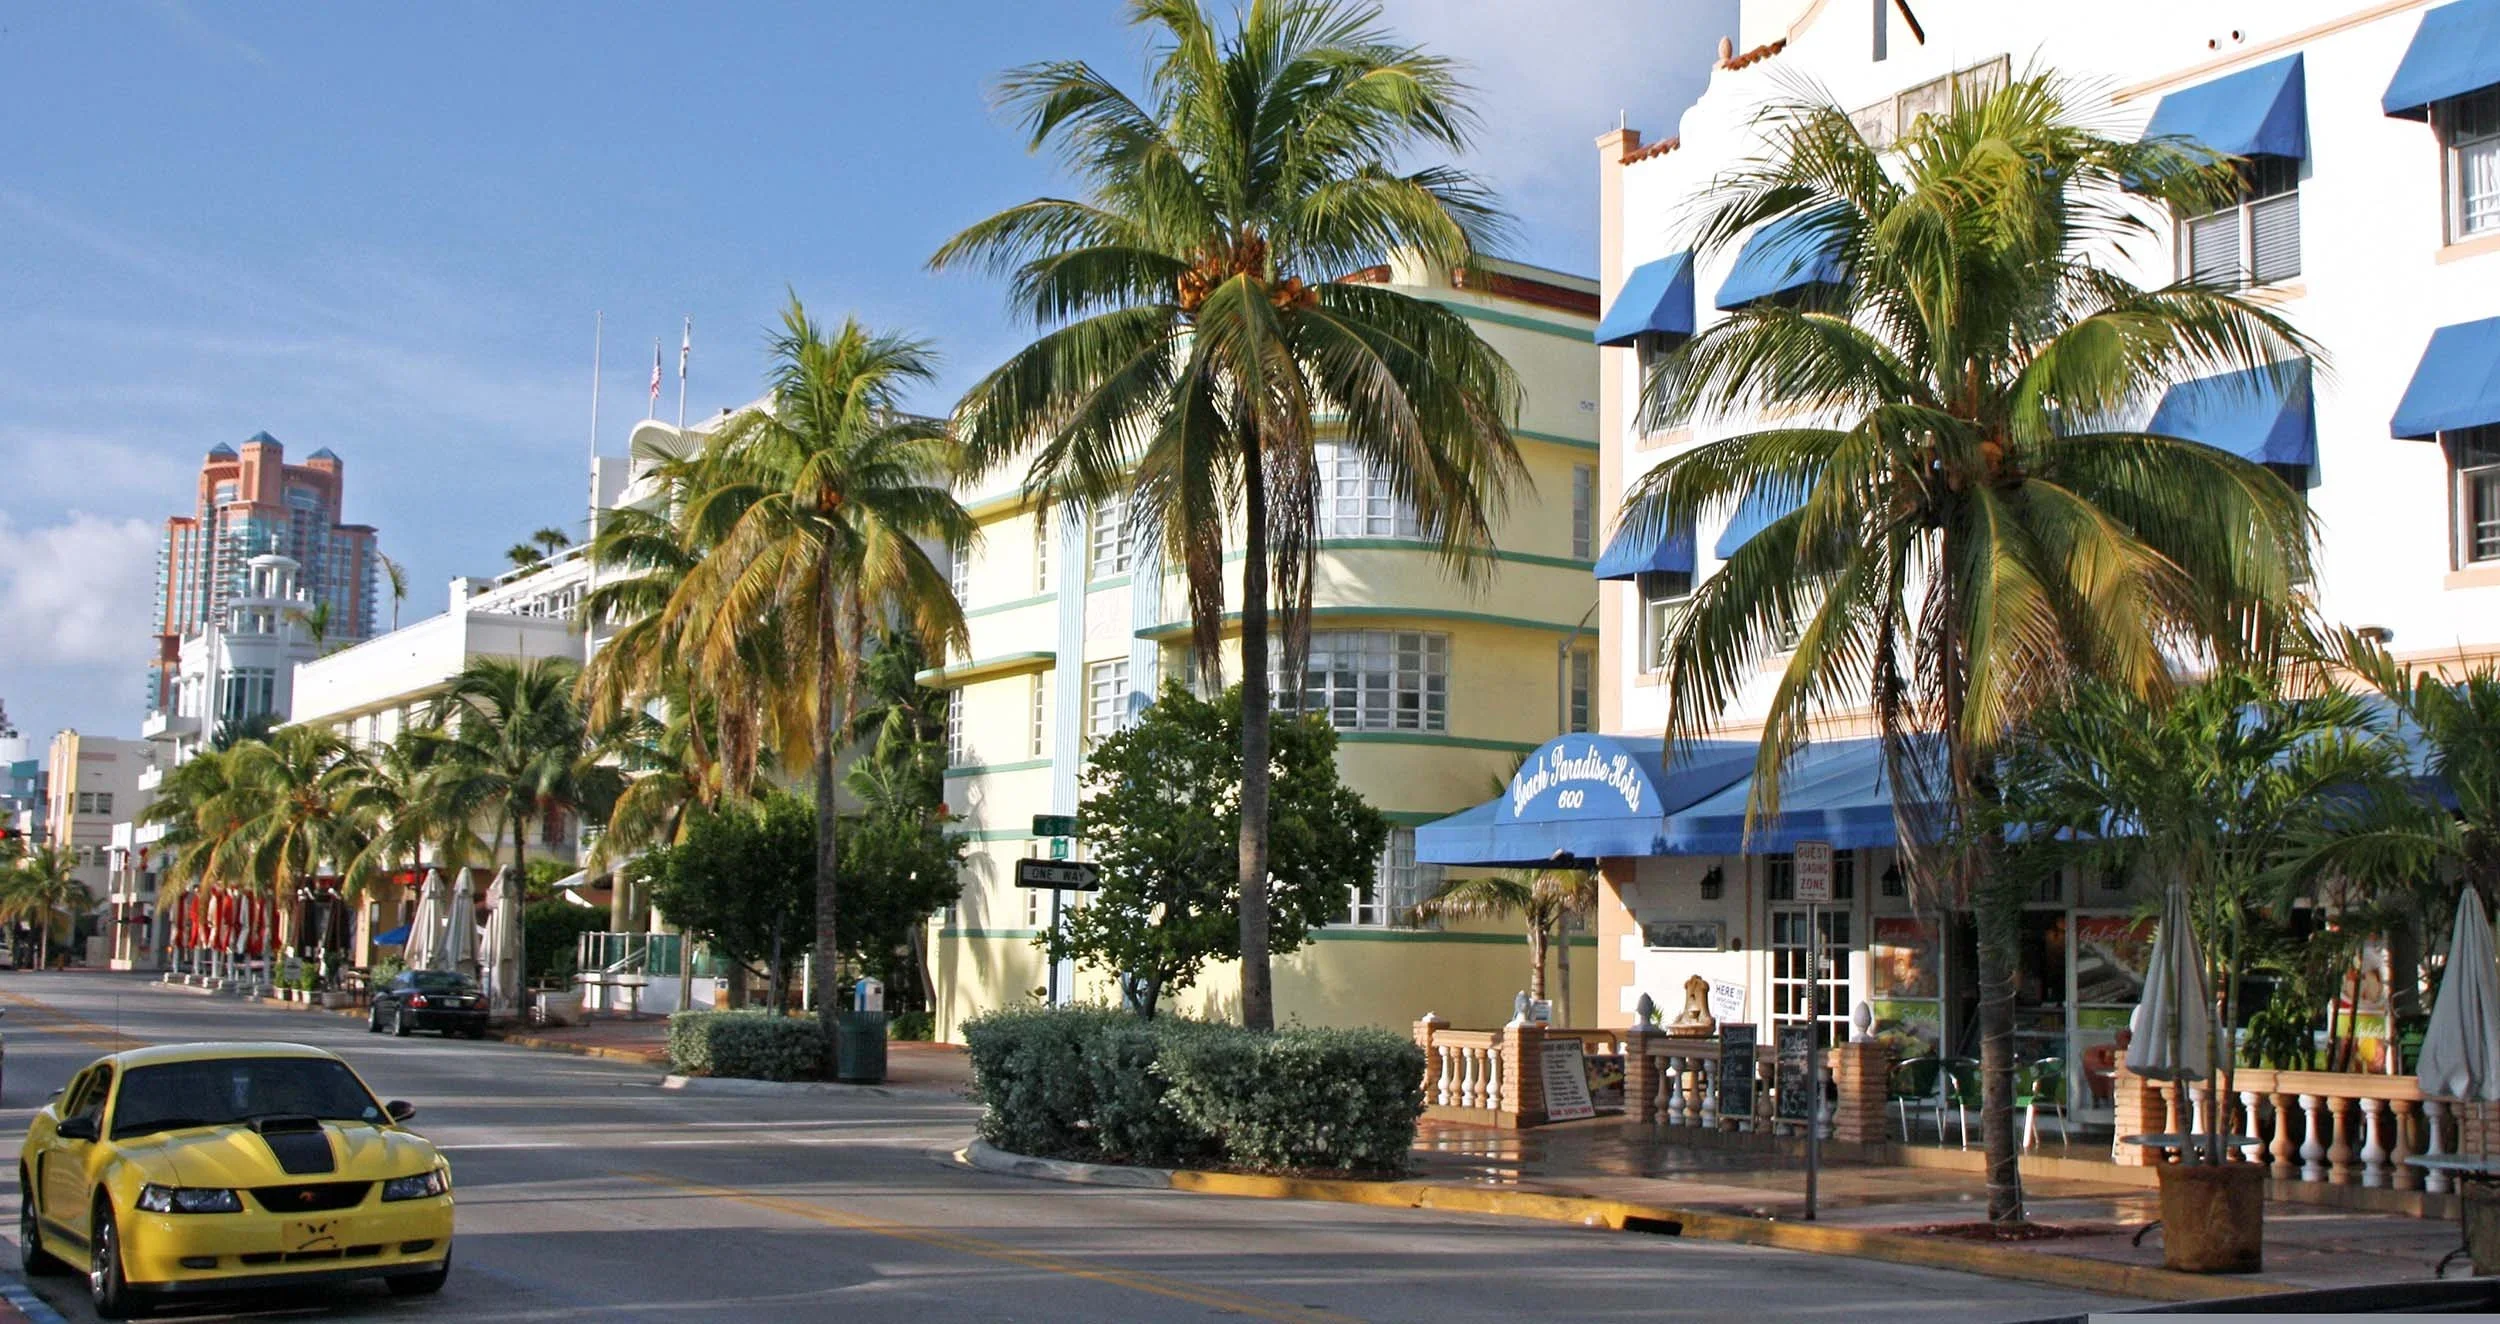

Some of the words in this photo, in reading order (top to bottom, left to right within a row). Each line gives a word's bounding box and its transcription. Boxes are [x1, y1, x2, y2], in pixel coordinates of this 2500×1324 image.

[1513, 756, 1549, 818] Beach
[1551, 744, 1609, 787] Paradise
[1608, 754, 1641, 813] Hotel
[1558, 789, 1584, 809] 600
[1799, 847, 1828, 859] GUEST
[1032, 867, 1053, 880] ONE
[1063, 870, 1085, 882] WAY
[1799, 862, 1828, 874] LOADING
[1800, 878, 1825, 890] ZONE
[1715, 984, 1735, 999] HERE
